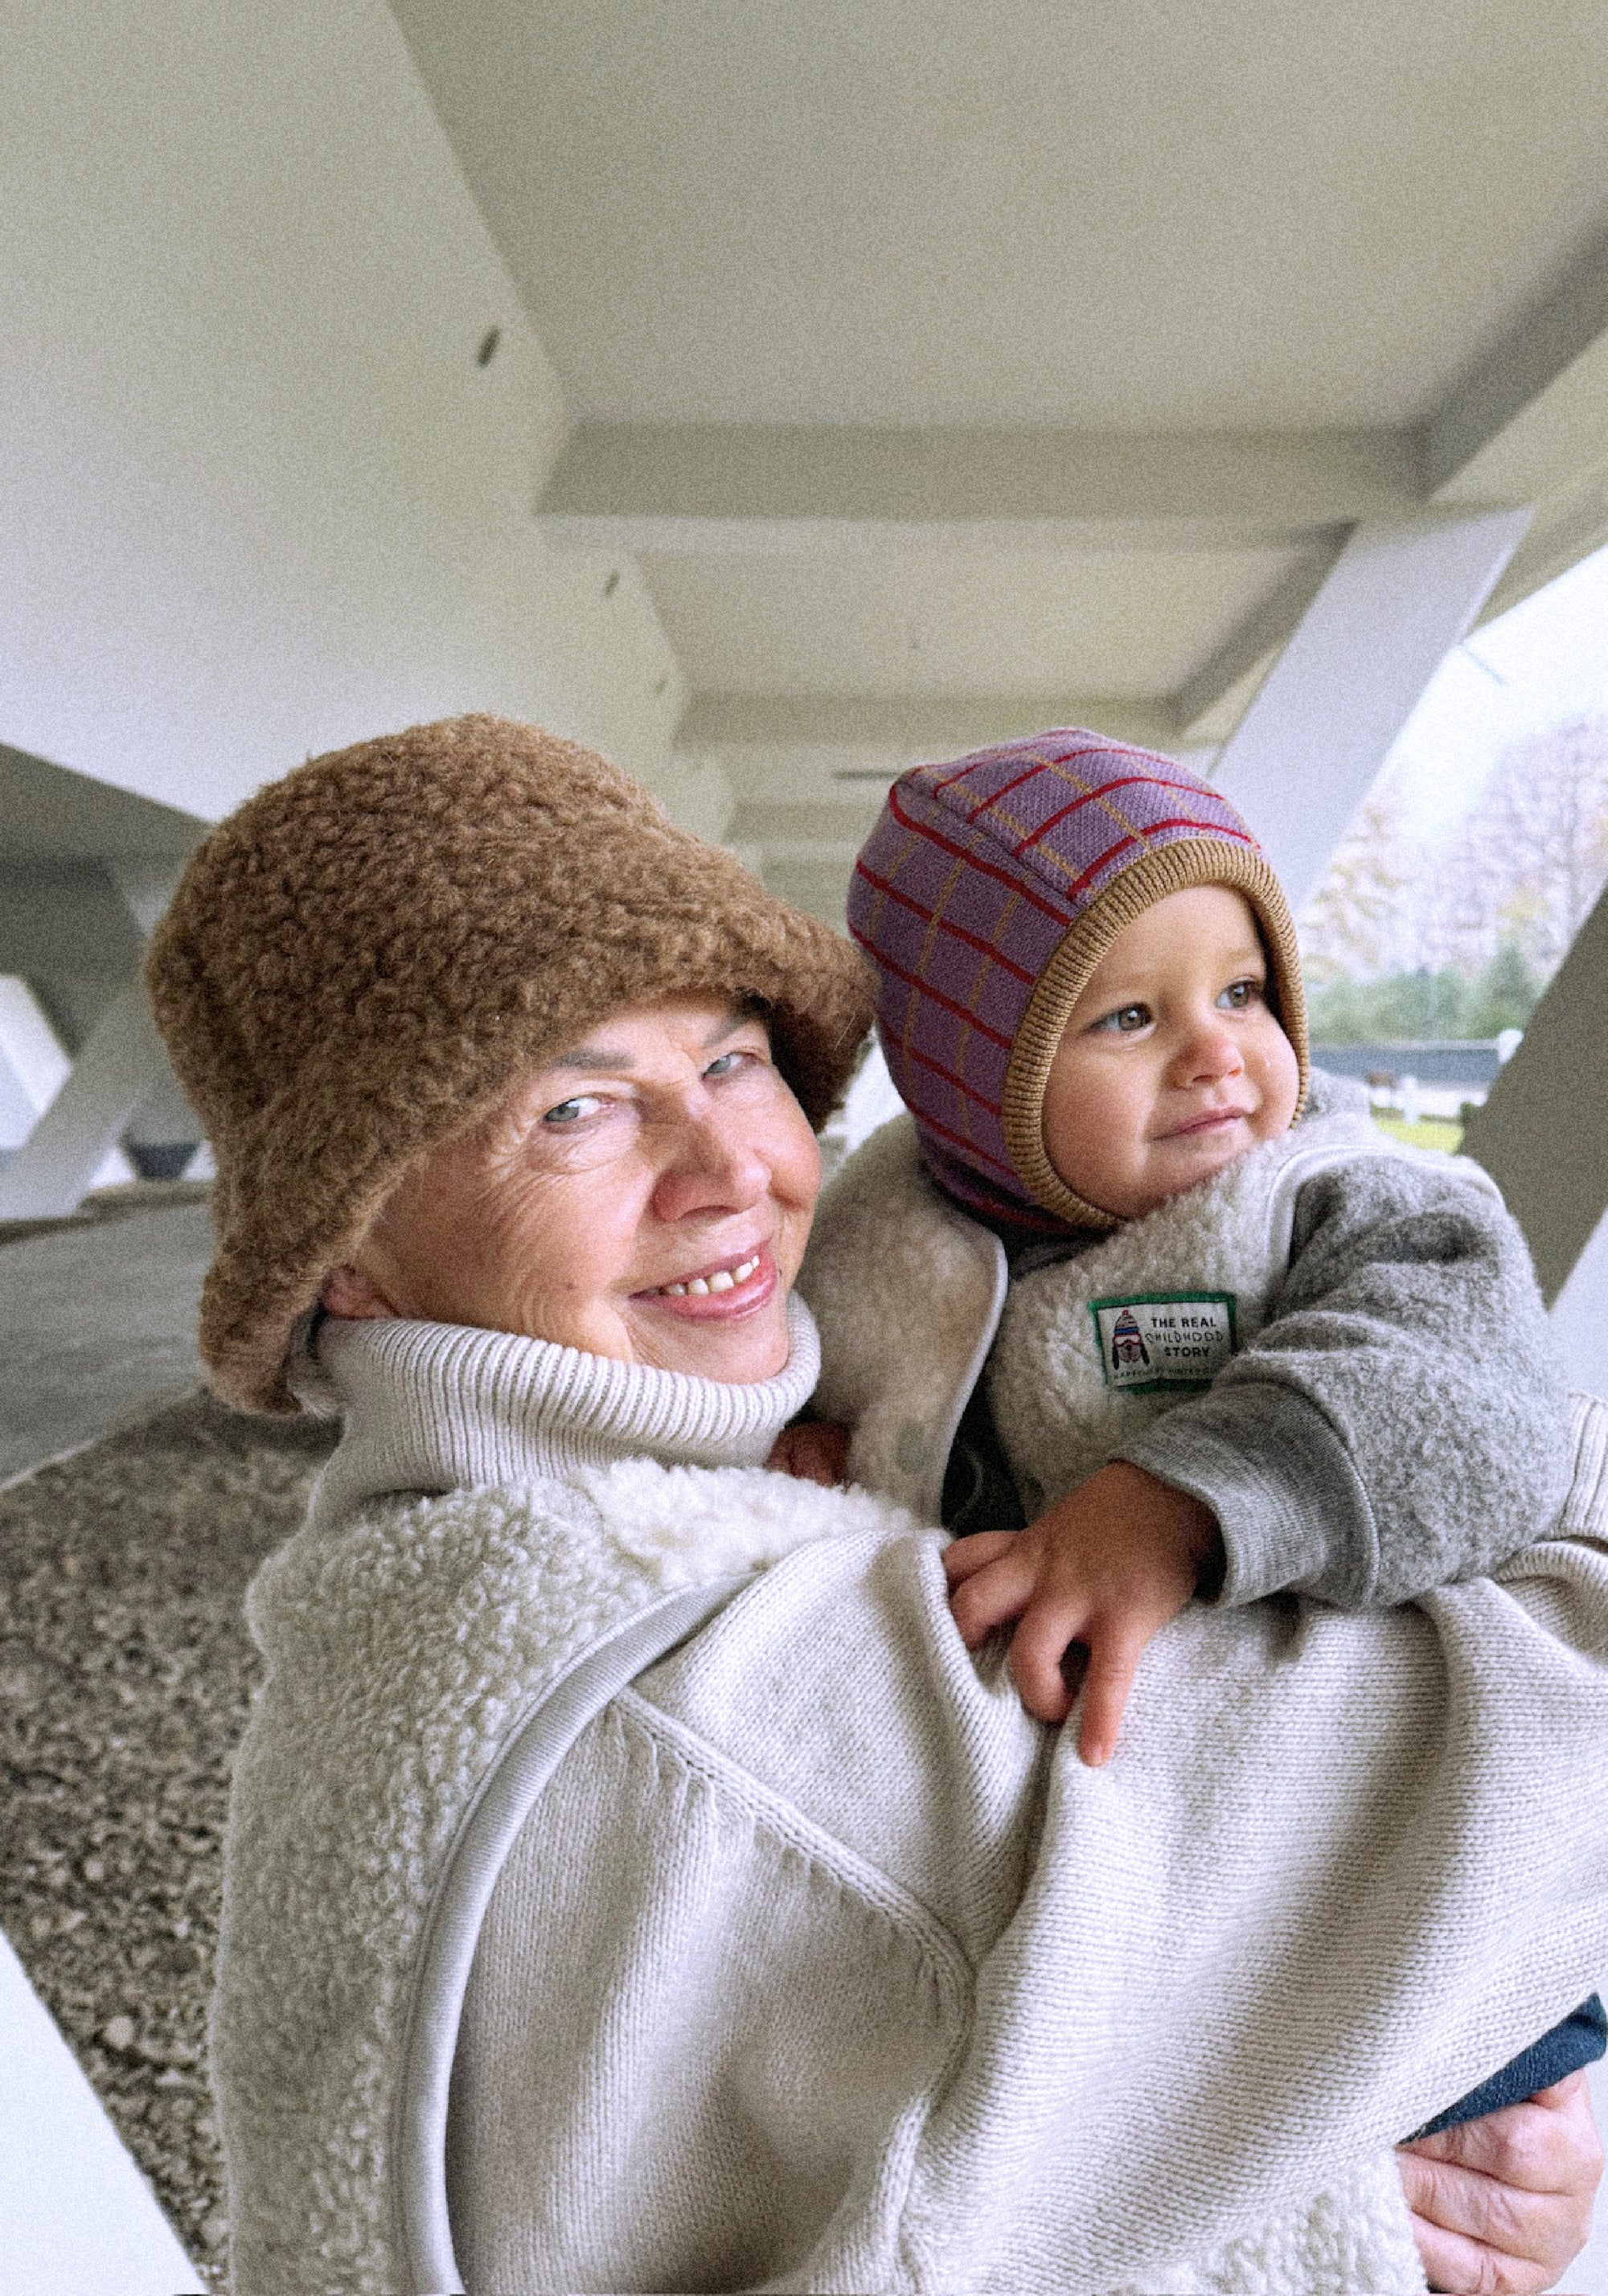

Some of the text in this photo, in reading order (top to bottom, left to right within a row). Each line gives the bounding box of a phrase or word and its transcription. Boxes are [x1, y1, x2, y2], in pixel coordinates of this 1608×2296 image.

[1151, 1316, 1216, 1328] THE REAL
[1145, 1331, 1224, 1343] CHILDHOOD
[1165, 1347, 1210, 1357] STORY
